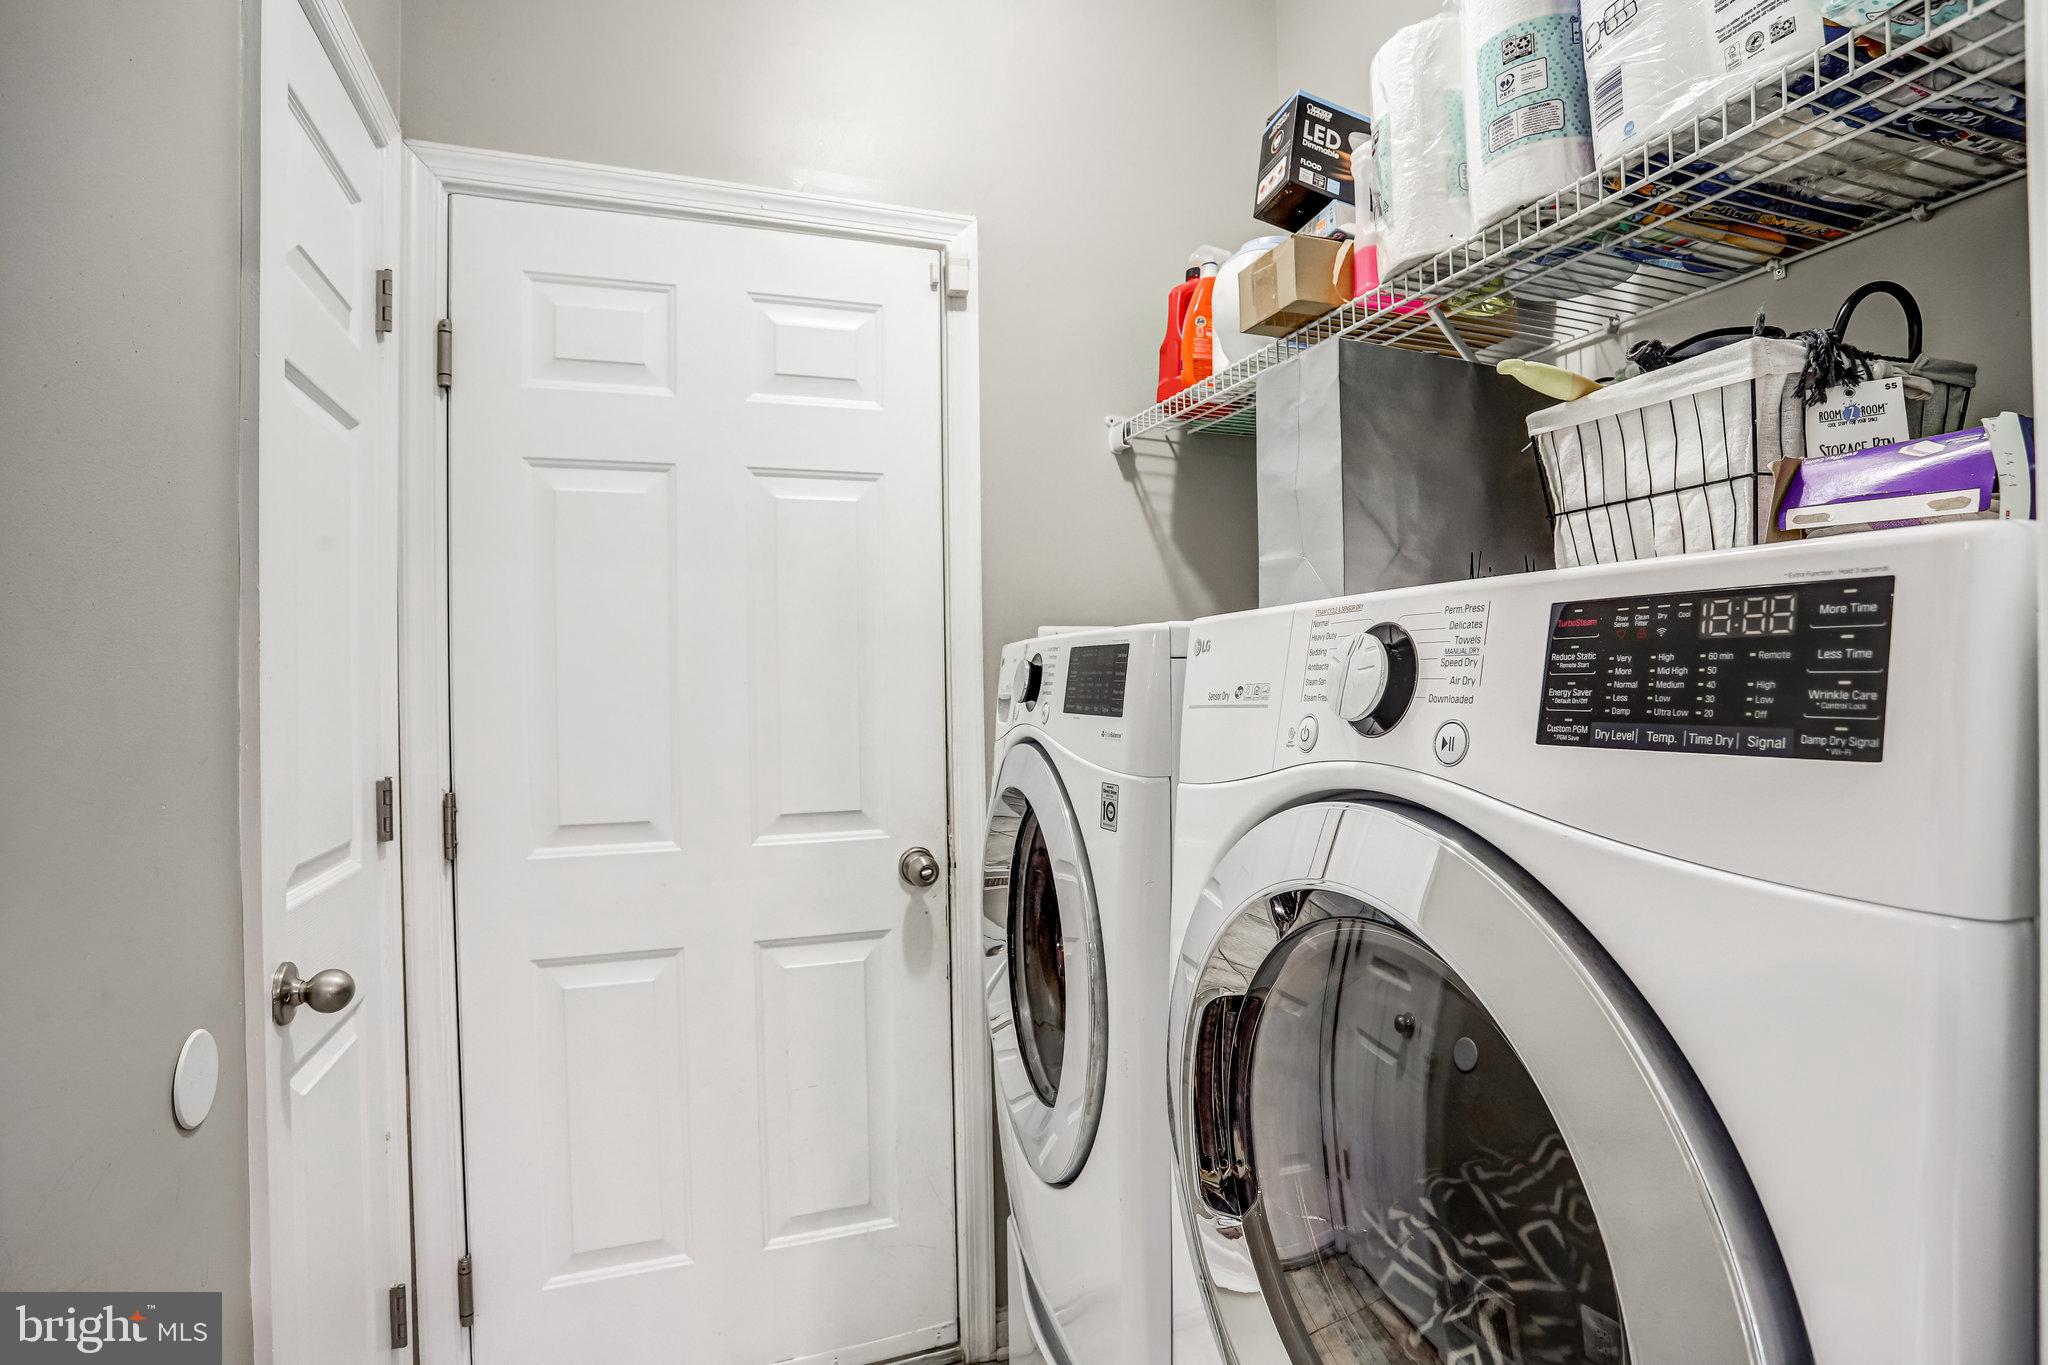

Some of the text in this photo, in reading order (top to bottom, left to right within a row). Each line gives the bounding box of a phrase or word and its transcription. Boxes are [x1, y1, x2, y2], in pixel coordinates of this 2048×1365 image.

[1303, 119, 1342, 150] LED
[1302, 139, 1339, 159] Dimmable
[1300, 157, 1322, 171] FLOOD
[1885, 382, 1898, 390] $5
[1819, 404, 1885, 420] ROOM 2 ROOM
[1444, 604, 1485, 614] Perm. Press
[1820, 602, 1878, 614] More Time
[1678, 610, 1691, 618] Cool
[1702, 595, 1795, 636] 18:88
[1313, 620, 1329, 628] Normal
[1449, 620, 1482, 630] Delicates
[1558, 618, 1597, 628] TurboSteam
[1312, 632, 1337, 642] Heavy Duty
[1454, 635, 1481, 644] Towels
[1202, 640, 1211, 652] LG
[1310, 649, 1327, 657] Bedding
[1577, 652, 1596, 660] Static
[1616, 654, 1632, 662] Very
[1658, 653, 1674, 662] High
[1720, 652, 1733, 660] min
[1758, 651, 1791, 659] Remote
[1818, 648, 1872, 659] Less Time
[1440, 658, 1478, 668] Speed Dry
[1671, 667, 1688, 676] High
[1450, 676, 1476, 687] Air Dry
[1756, 681, 1776, 690] High
[1208, 691, 1230, 702] Sensor Dry
[1549, 688, 1571, 697] Energy
[1808, 690, 1878, 700] Wrinkle Care
[1303, 694, 1317, 702] Steam
[1428, 694, 1474, 704] Downloaded
[1705, 695, 1715, 703] 30
[1755, 696, 1774, 704] Low
[1611, 707, 1630, 716] Damp
[1654, 708, 1671, 716] Ultra
[1754, 710, 1768, 719] Off
[1547, 724, 1588, 734] Custom PGM
[1595, 729, 1634, 741] Dry Level
[1647, 731, 1677, 745] Temp.
[1689, 733, 1734, 749] Time Dry
[1747, 735, 1786, 750] Signal
[1801, 735, 1878, 749] Damp Dry Signal
[1103, 800, 1115, 822] 10
